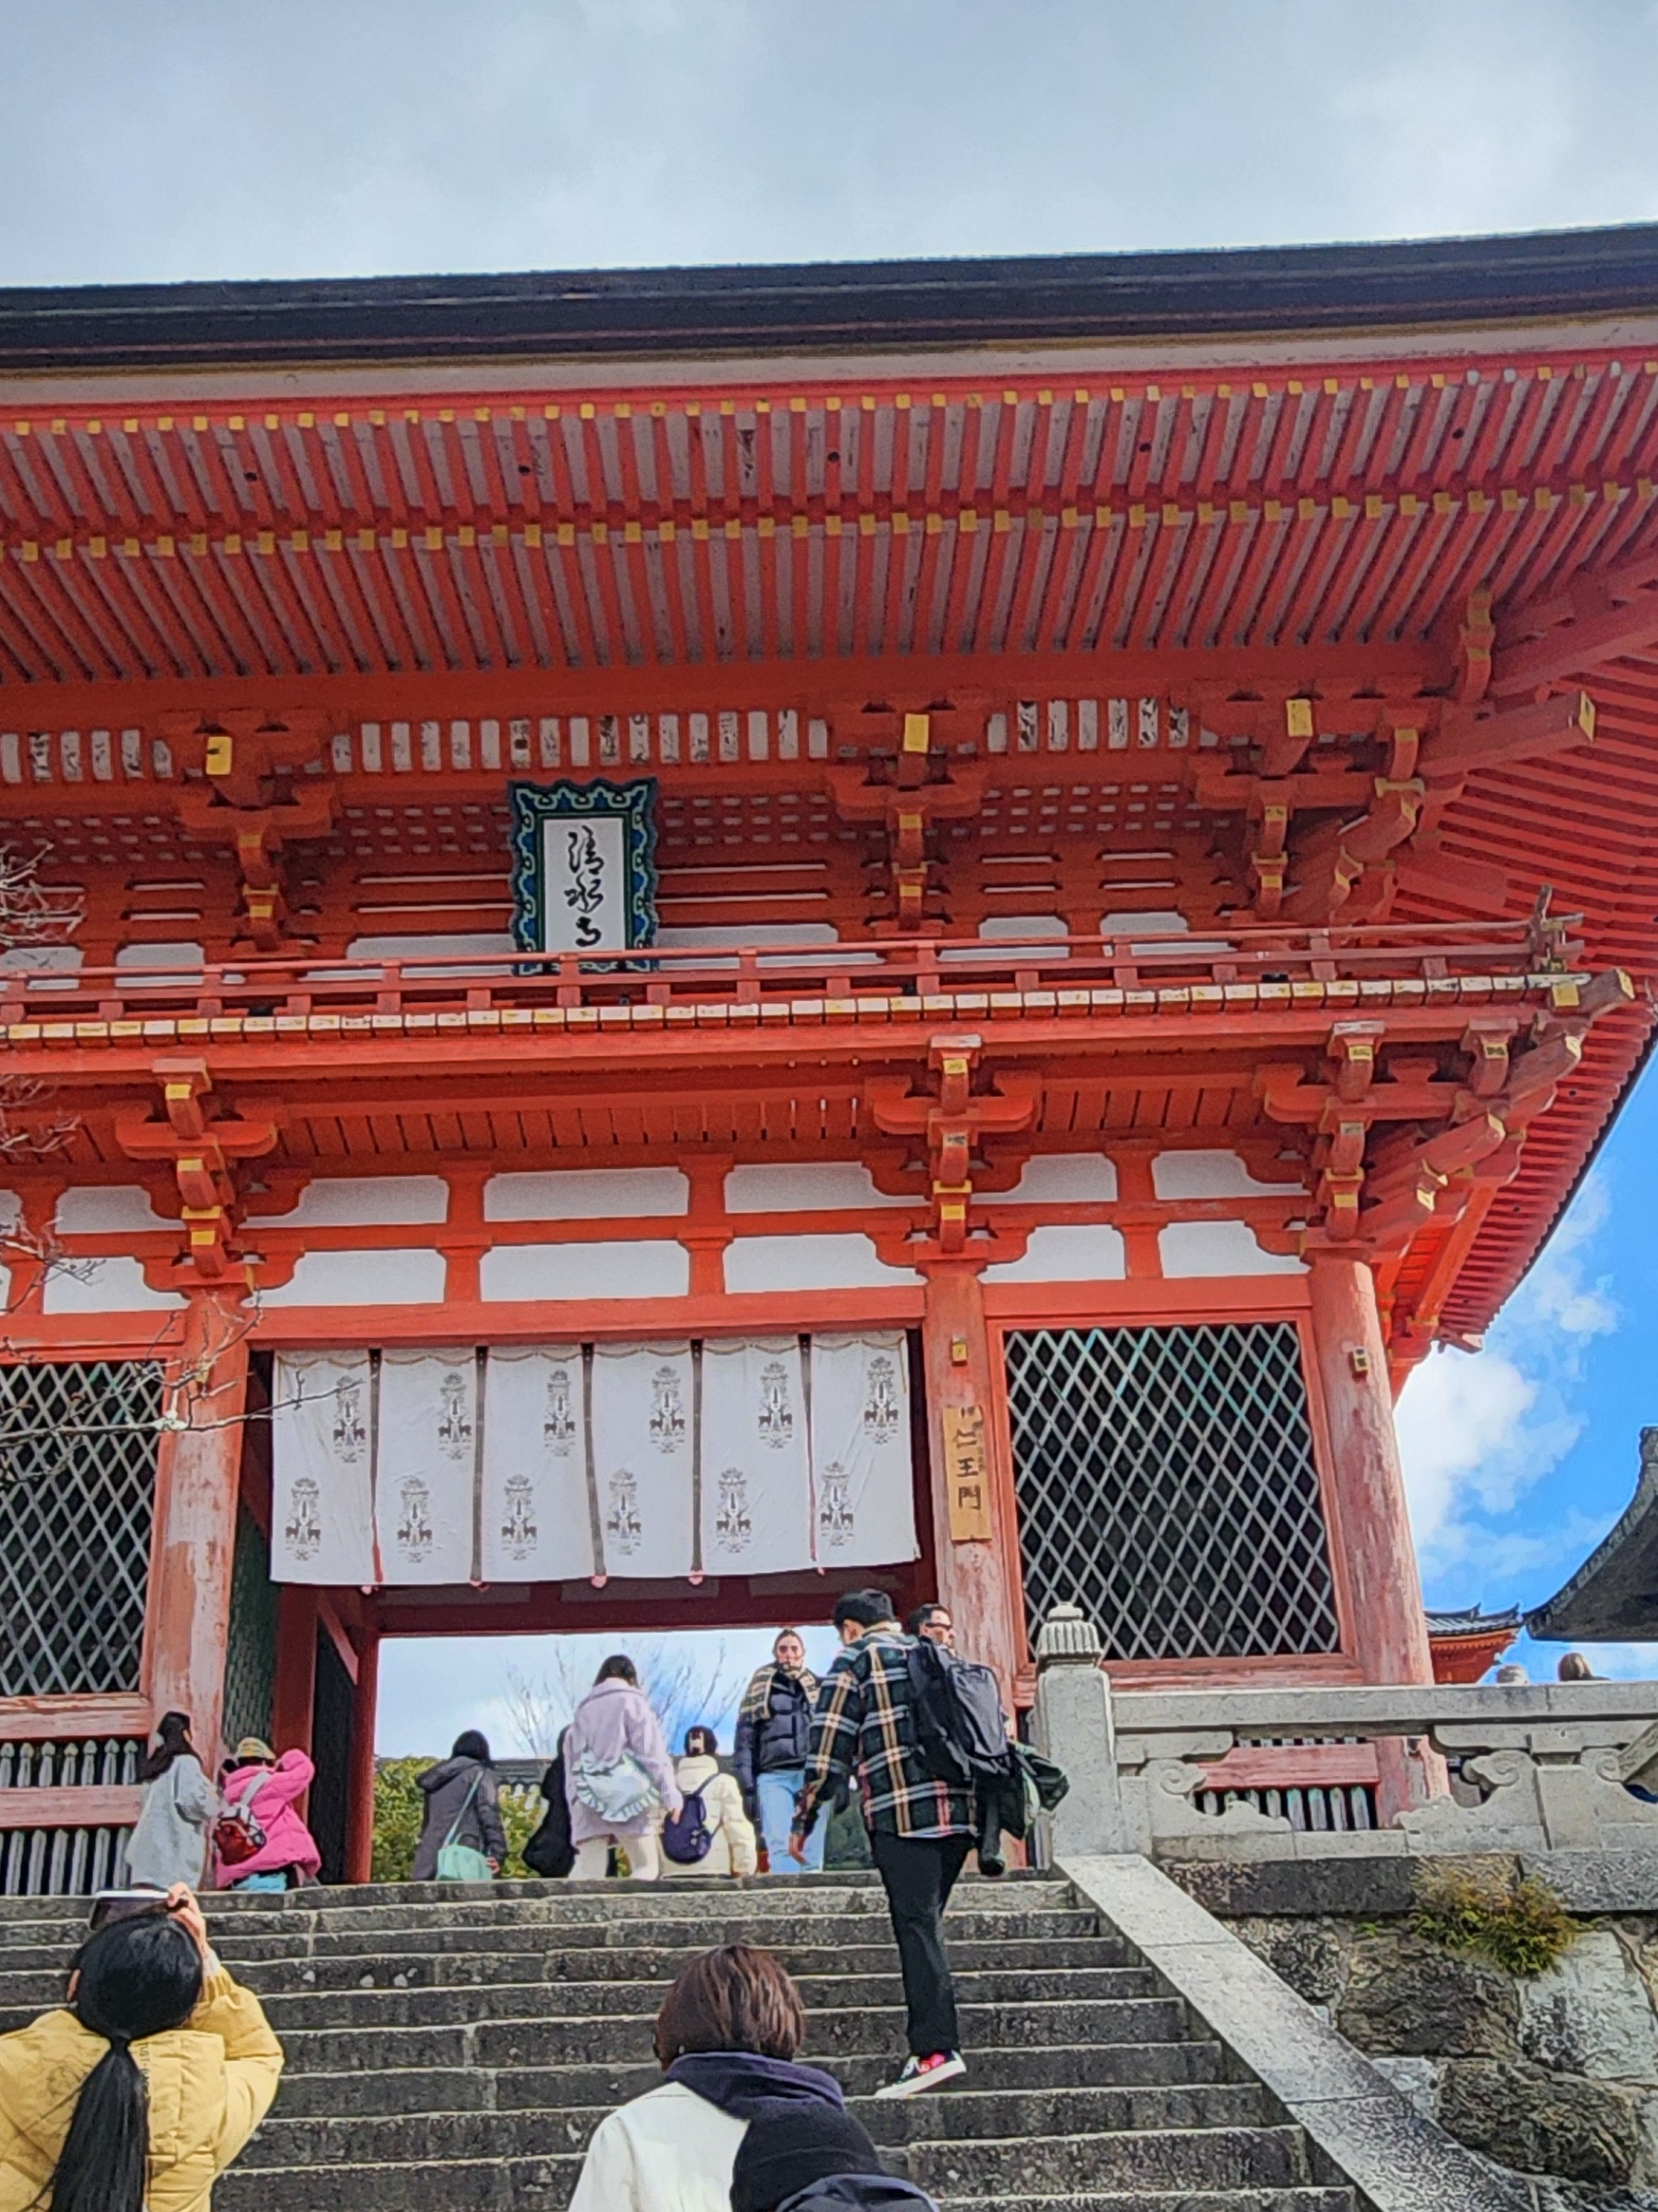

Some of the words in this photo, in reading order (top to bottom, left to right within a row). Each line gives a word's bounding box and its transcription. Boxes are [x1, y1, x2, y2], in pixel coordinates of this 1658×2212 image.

[564, 824, 605, 947] 清水寺
[952, 1428, 981, 1510] 仁王門
